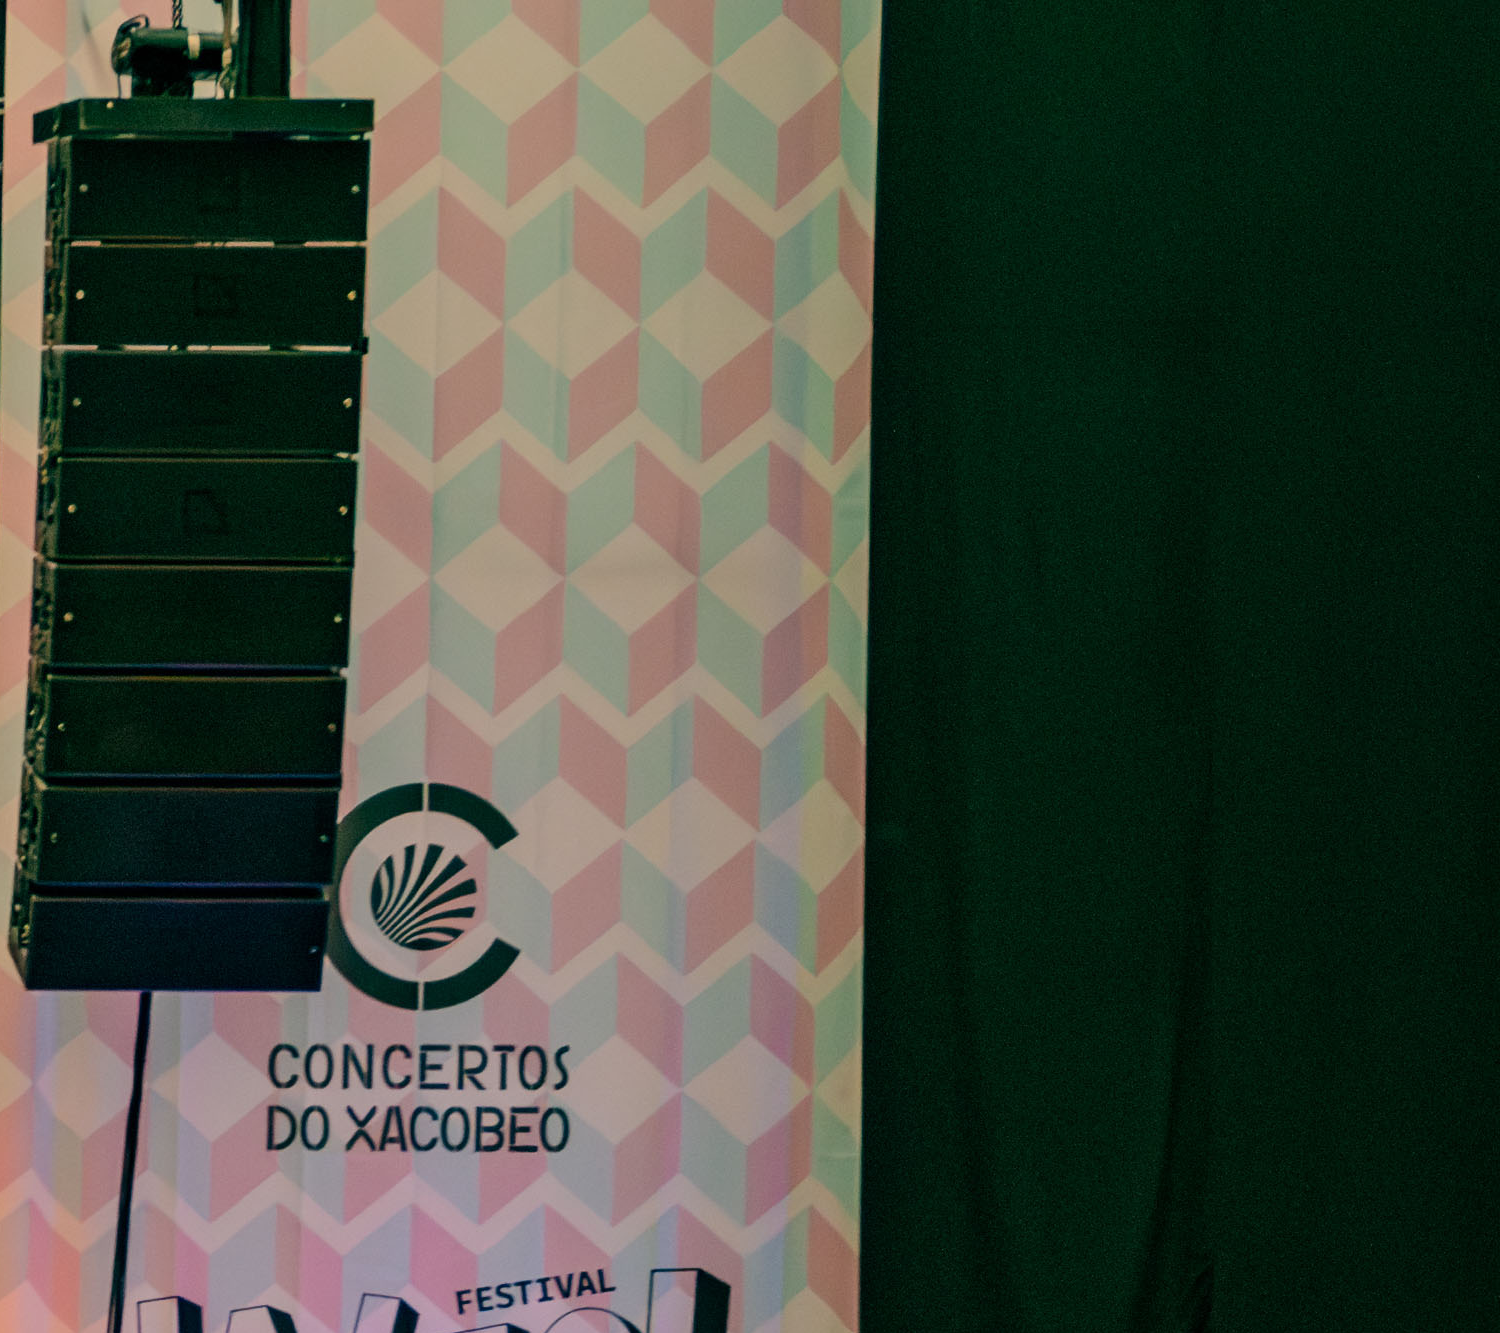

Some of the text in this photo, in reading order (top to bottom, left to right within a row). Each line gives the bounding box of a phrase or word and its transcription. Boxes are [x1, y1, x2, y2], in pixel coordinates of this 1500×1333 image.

[268, 1043, 571, 1091] CONCERTOS
[266, 1105, 570, 1152] DO XACOBEO
[455, 1268, 617, 1315] FESTIVAL
